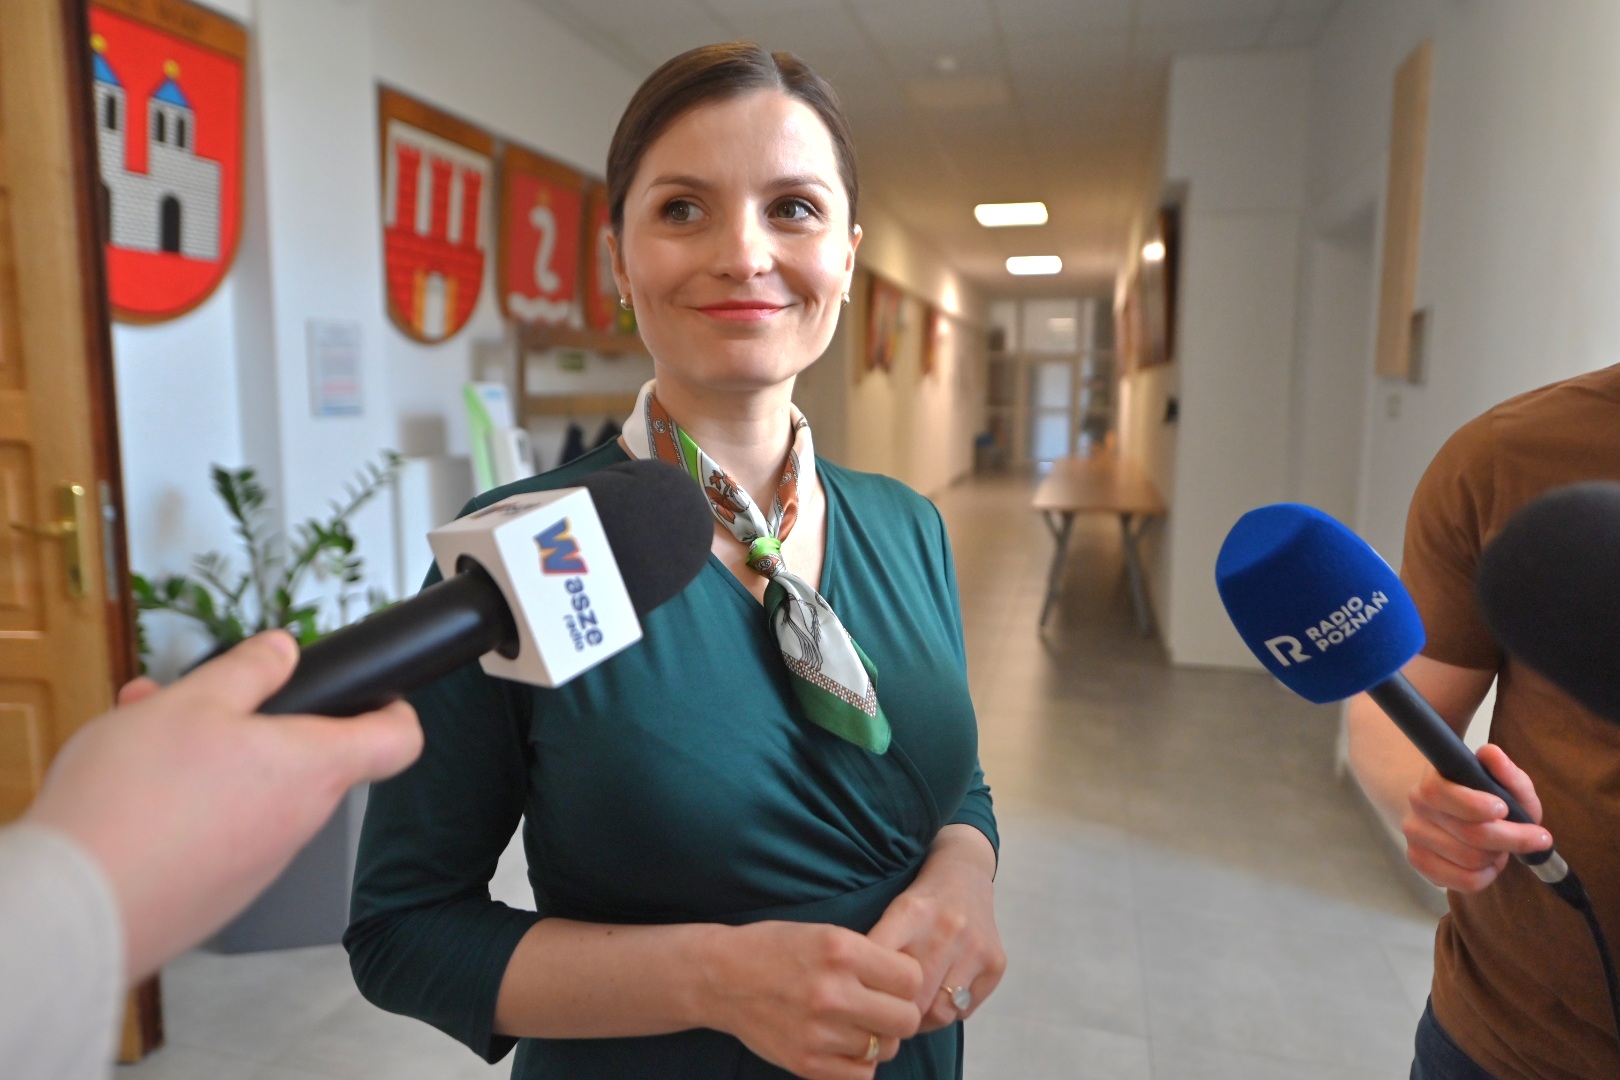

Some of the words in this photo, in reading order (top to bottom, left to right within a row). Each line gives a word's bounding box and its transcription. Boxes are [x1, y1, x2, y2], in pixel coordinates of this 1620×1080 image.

[533, 517, 603, 646] Wasze
[563, 614, 585, 652] radio
[1305, 596, 1364, 641] RADIO
[1315, 590, 1389, 652] POZNAŃ
[1264, 635, 1312, 667] R
